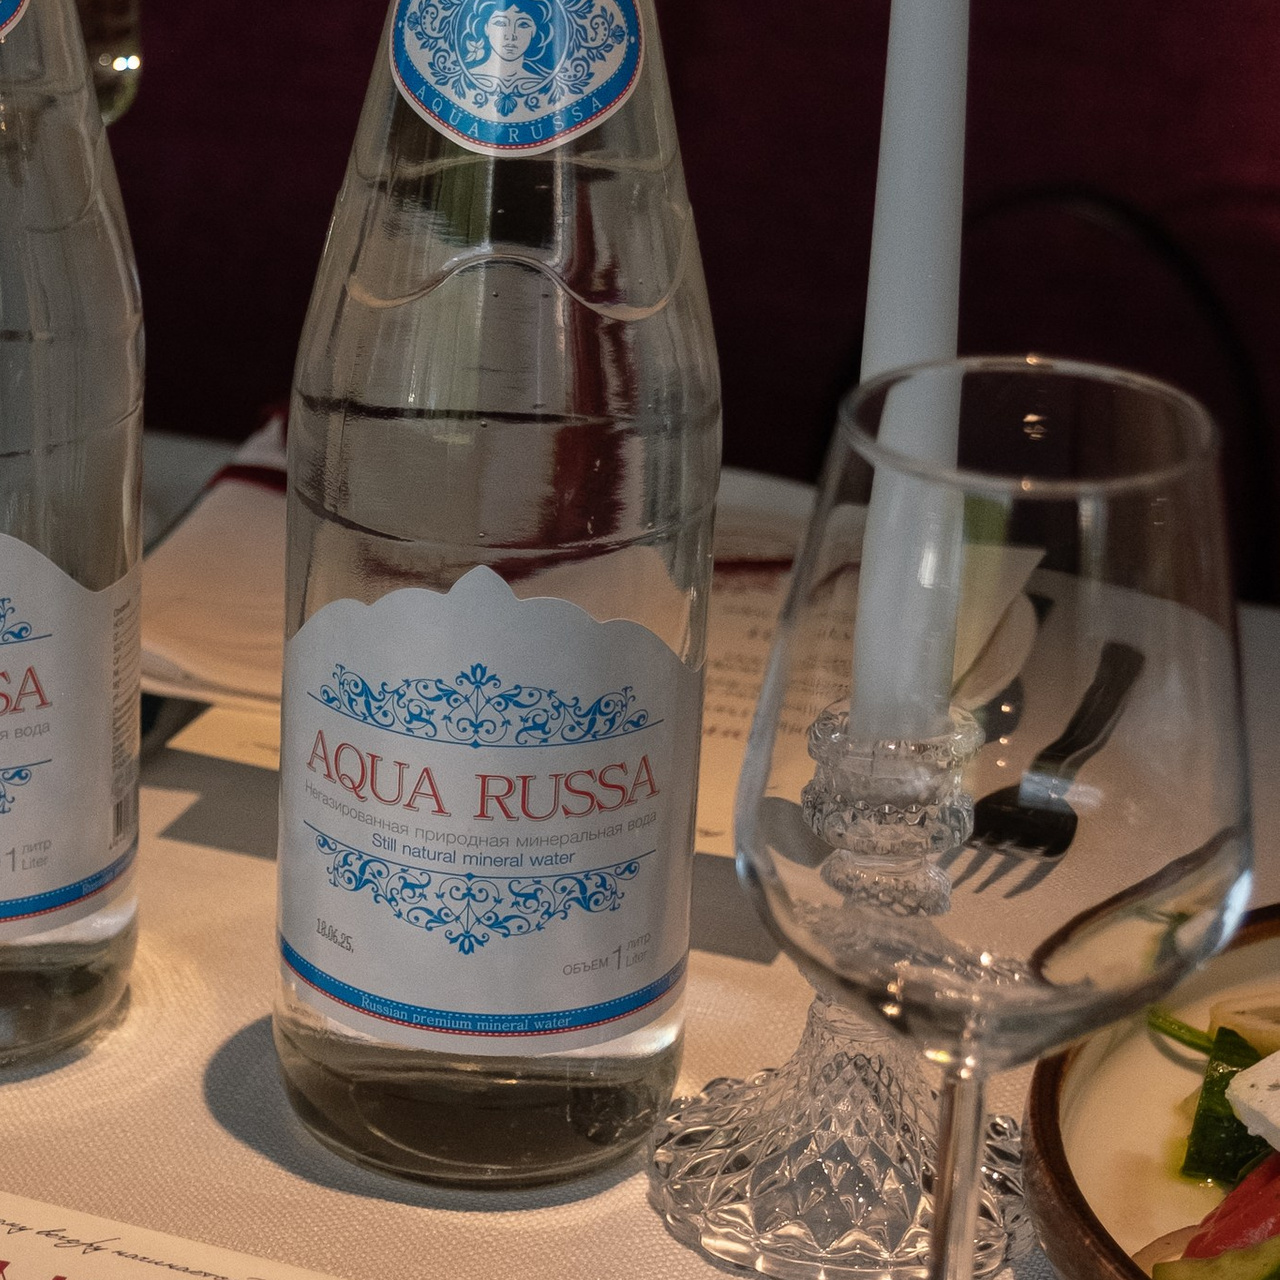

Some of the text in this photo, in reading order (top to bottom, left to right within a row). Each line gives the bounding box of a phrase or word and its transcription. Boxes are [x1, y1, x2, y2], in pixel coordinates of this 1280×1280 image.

[416, 85, 603, 143] AQUA RUSSA
[14, 722, 50, 738] вода
[306, 729, 660, 822] AQUA RUSSA
[304, 778, 657, 848] Негазированная природная минеральная вода
[5, 847, 16, 872] 1
[22, 839, 52, 854] литр
[372, 832, 576, 867] Still natural mineral water
[21, 856, 48, 870] Liter
[562, 945, 621, 976] ОБЪЕМ 1
[625, 950, 647, 967] Liter
[361, 995, 572, 1031] Russian premium mineral water
